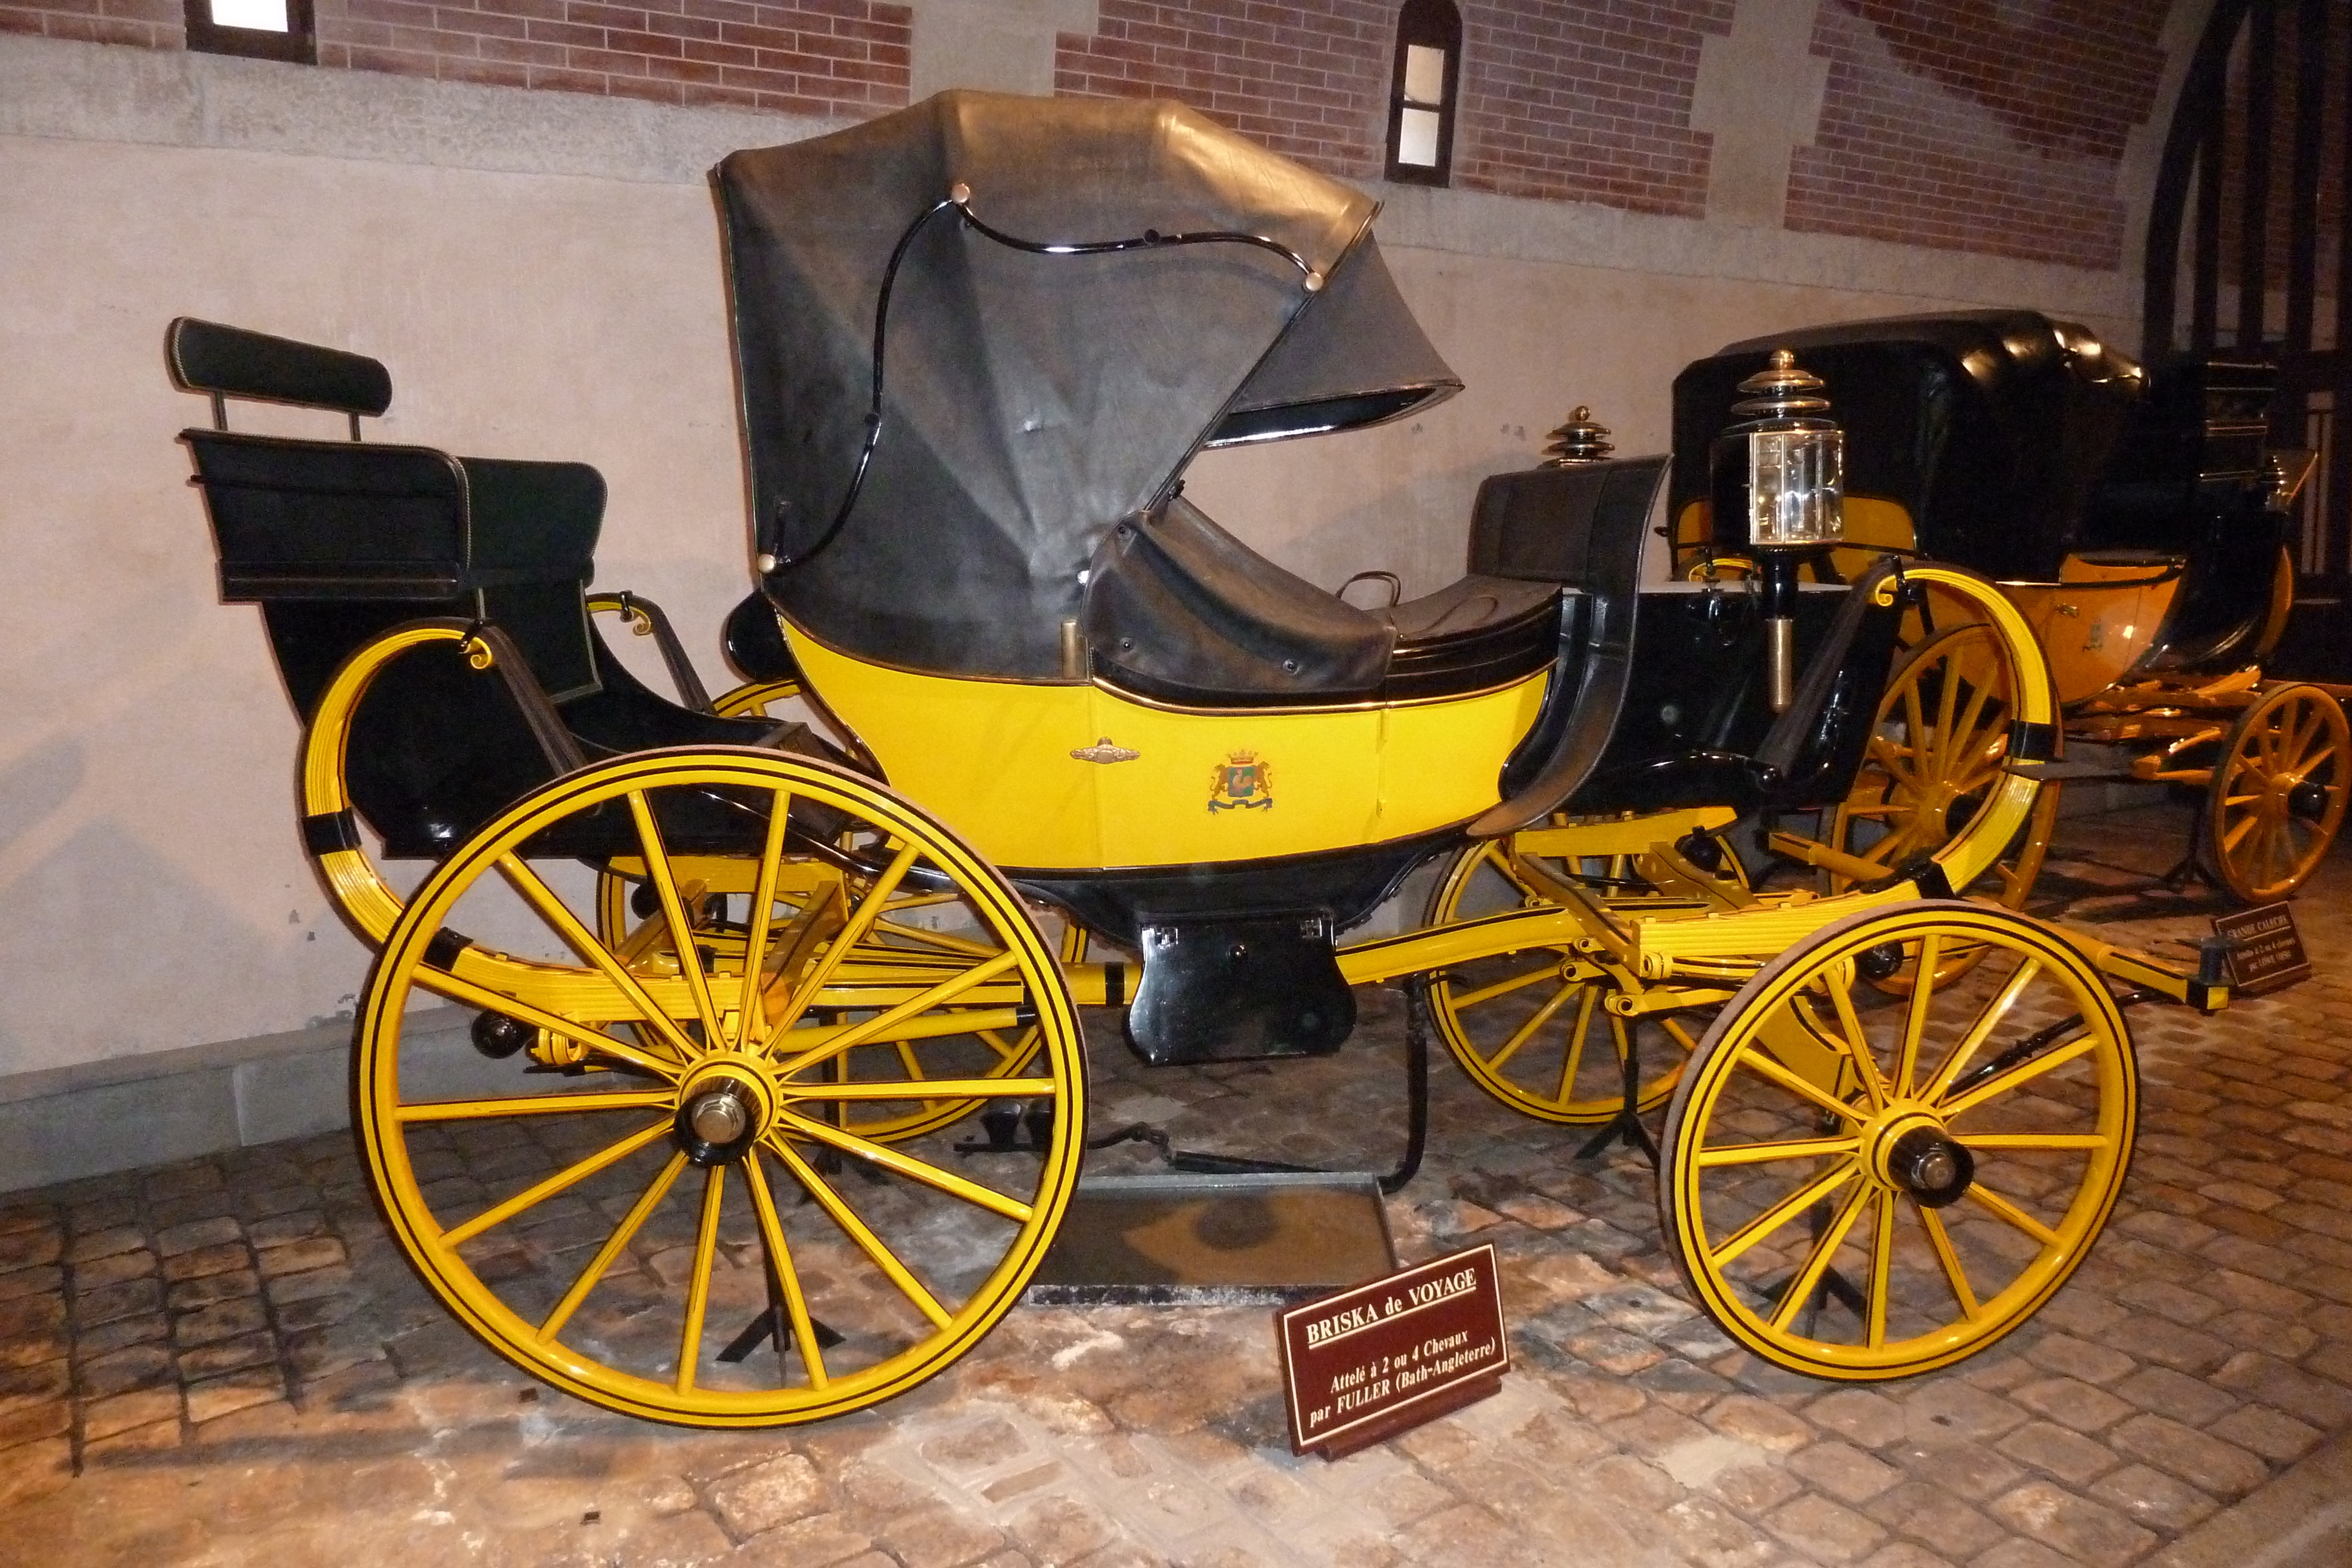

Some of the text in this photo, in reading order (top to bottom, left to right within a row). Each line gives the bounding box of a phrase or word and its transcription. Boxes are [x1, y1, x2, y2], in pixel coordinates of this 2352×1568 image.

[1306, 1268, 1476, 1344] BRISKA de VOYAGE
[1310, 1336, 1496, 1428] par FULLER (Bath-Angleterre)
[1331, 1330, 1468, 1394] Attelé à 2 ou 4 Chevaux
